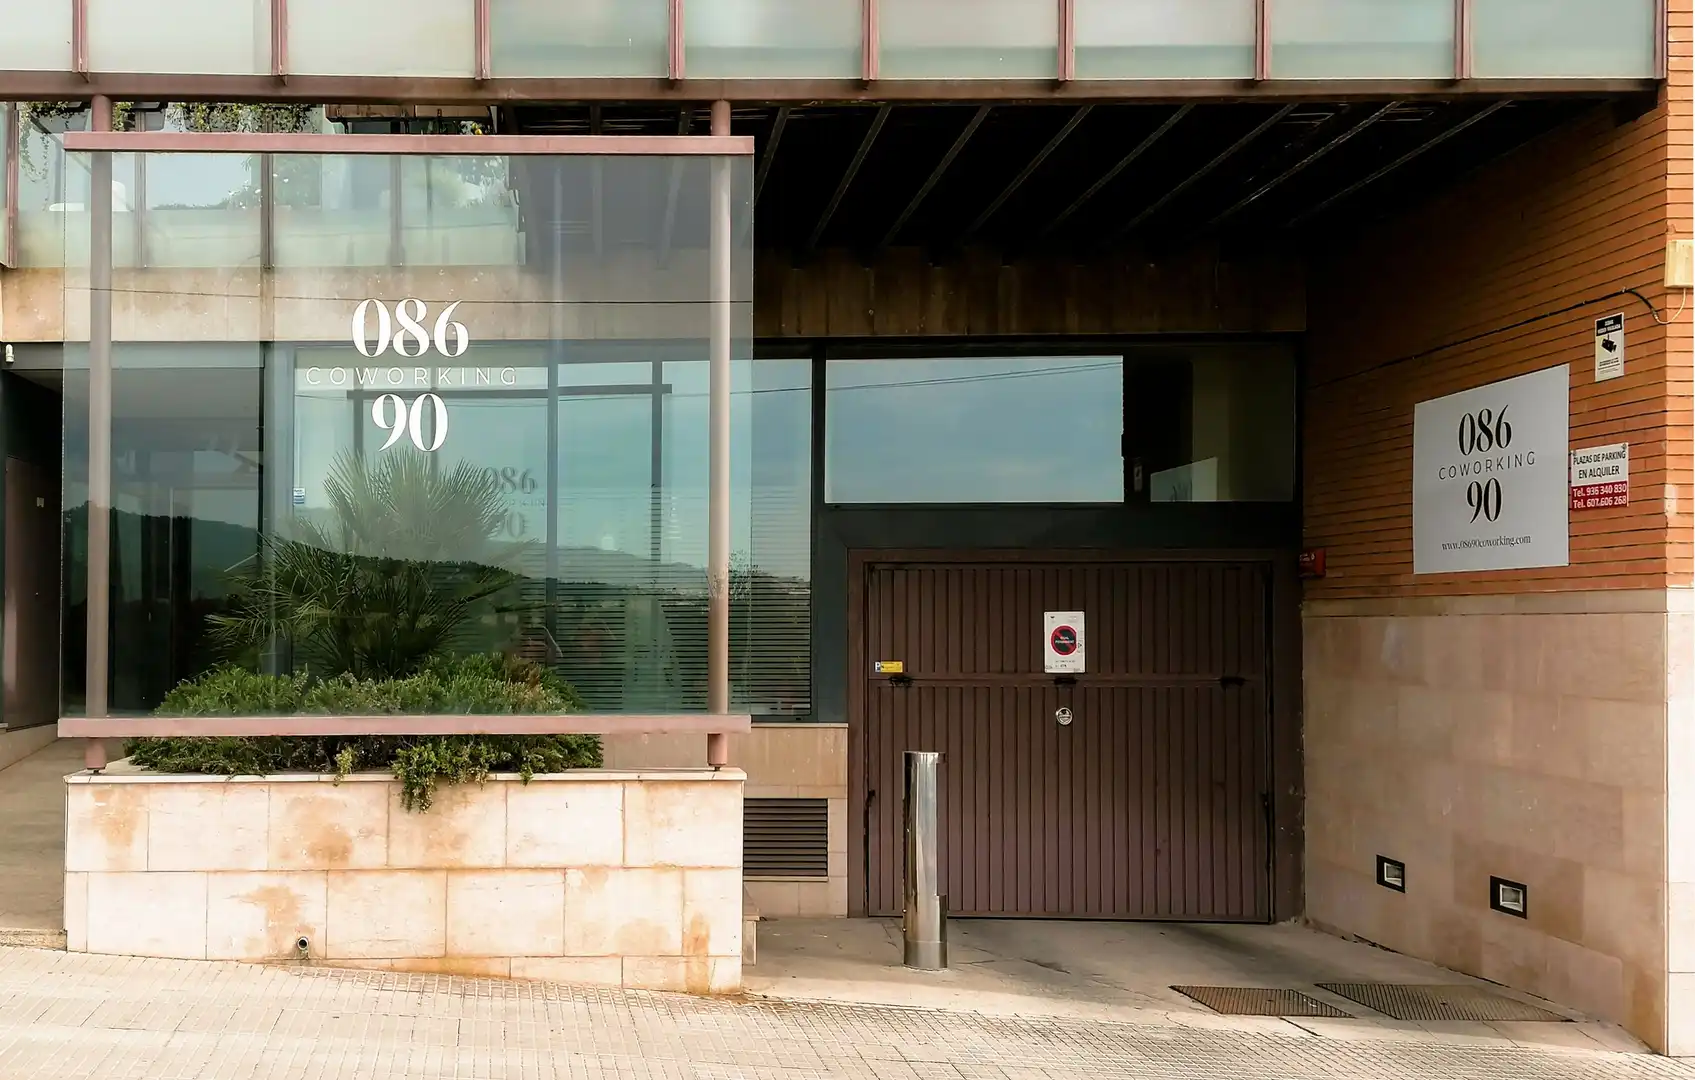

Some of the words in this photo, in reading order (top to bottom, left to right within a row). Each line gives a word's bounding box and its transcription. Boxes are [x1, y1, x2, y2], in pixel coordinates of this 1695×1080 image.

[351, 298, 469, 357] 086
[306, 366, 517, 385] COWORKING
[371, 393, 449, 452] 90
[1458, 404, 1513, 456] 086
[1438, 451, 1536, 480] COWORKING
[1573, 454, 1593, 465] PLAZAS
[1593, 453, 1601, 463] DE
[1601, 450, 1626, 461] PARKING
[1578, 469, 1588, 479] EN
[1588, 465, 1620, 478] ALQUILER
[1467, 477, 1502, 524] 90
[1441, 535, 1532, 551] www.08690coworking.com
